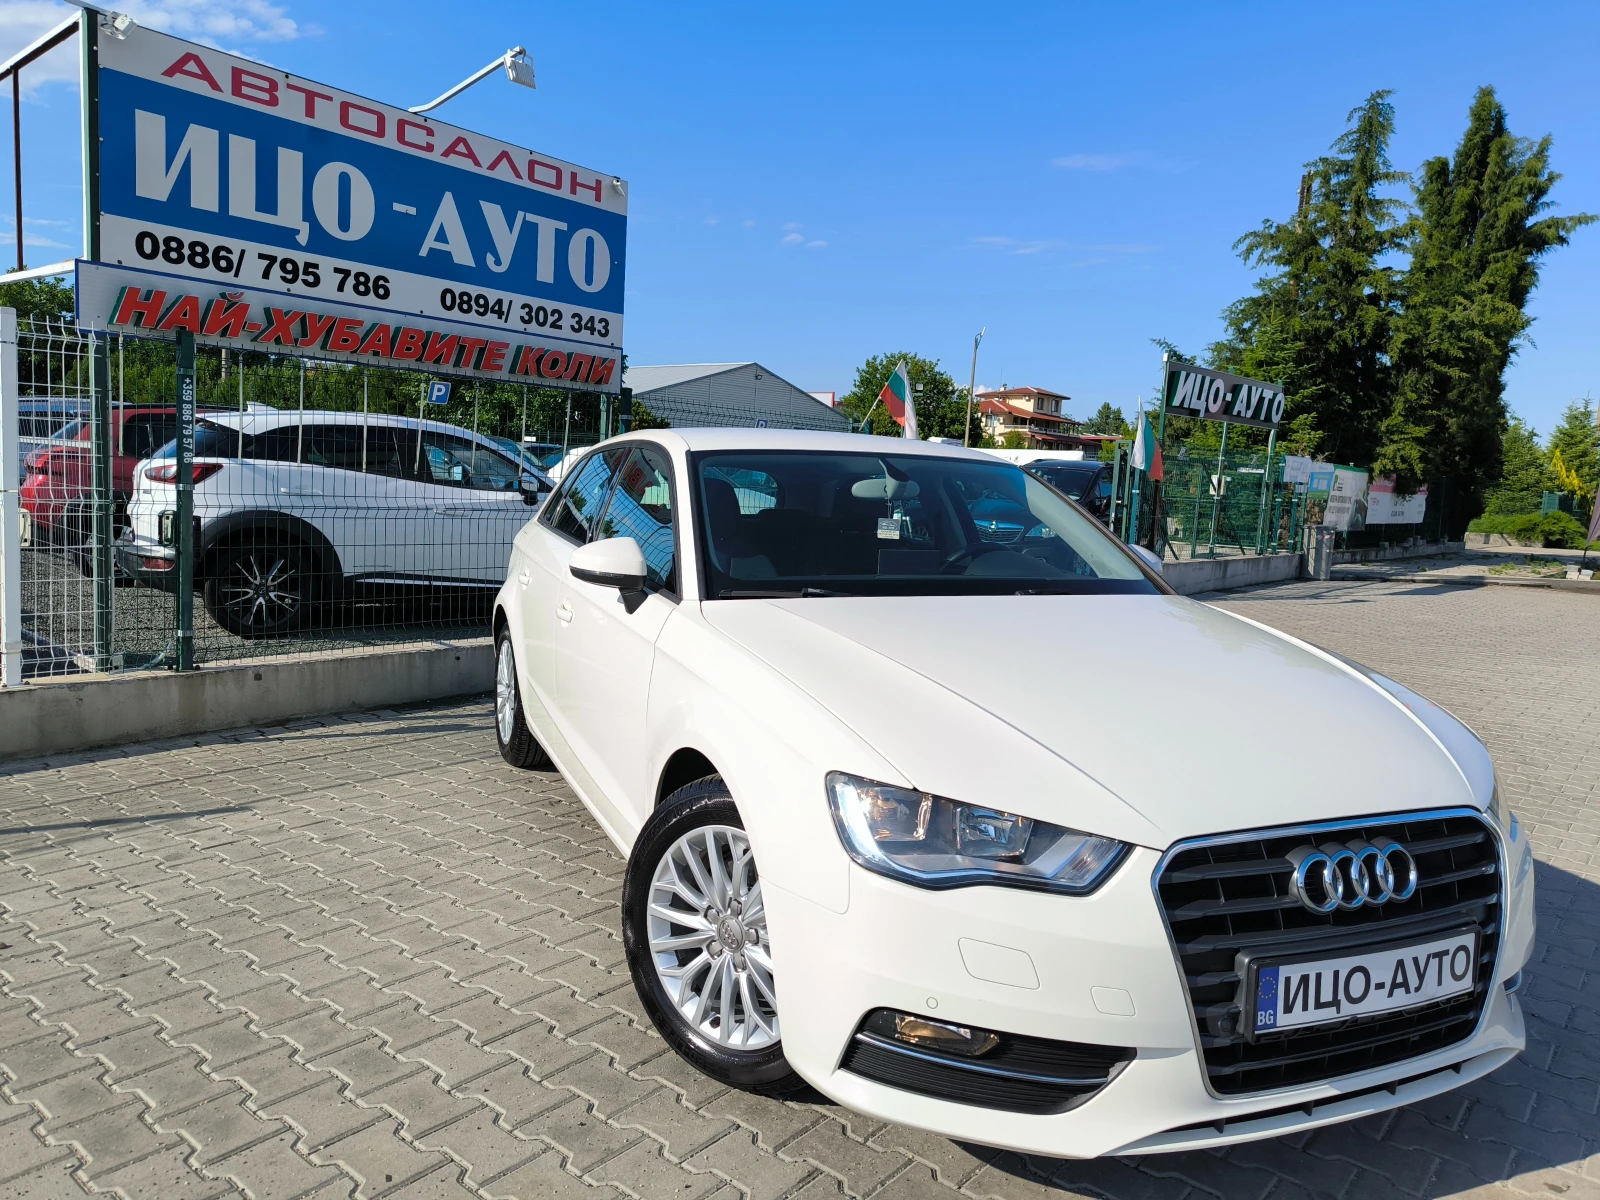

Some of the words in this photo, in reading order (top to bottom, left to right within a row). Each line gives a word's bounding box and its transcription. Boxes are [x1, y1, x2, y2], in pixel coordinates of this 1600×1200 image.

[163, 52, 602, 202] АВТОСАЛОН
[135, 230, 246, 278] 0886/
[257, 252, 321, 288] 795
[333, 266, 391, 301] 786
[440, 287, 513, 324] 0894/
[519, 303, 563, 331] 302
[570, 312, 610, 338] 343
[113, 286, 510, 371] НАЙ-ХУБАВИТЕ
[516, 345, 616, 385] КОЛИ
[183, 378, 193, 401] +359
[431, 384, 446, 401] P
[1173, 370, 1285, 424] ИЦО-АУТО
[182, 403, 193, 421] 886
[183, 423, 193, 435] 79
[183, 437, 193, 450] 57
[183, 451, 193, 464] 86
[1282, 944, 1471, 1015] ИЦО-АУТО
[1257, 1009, 1274, 1026] BG
